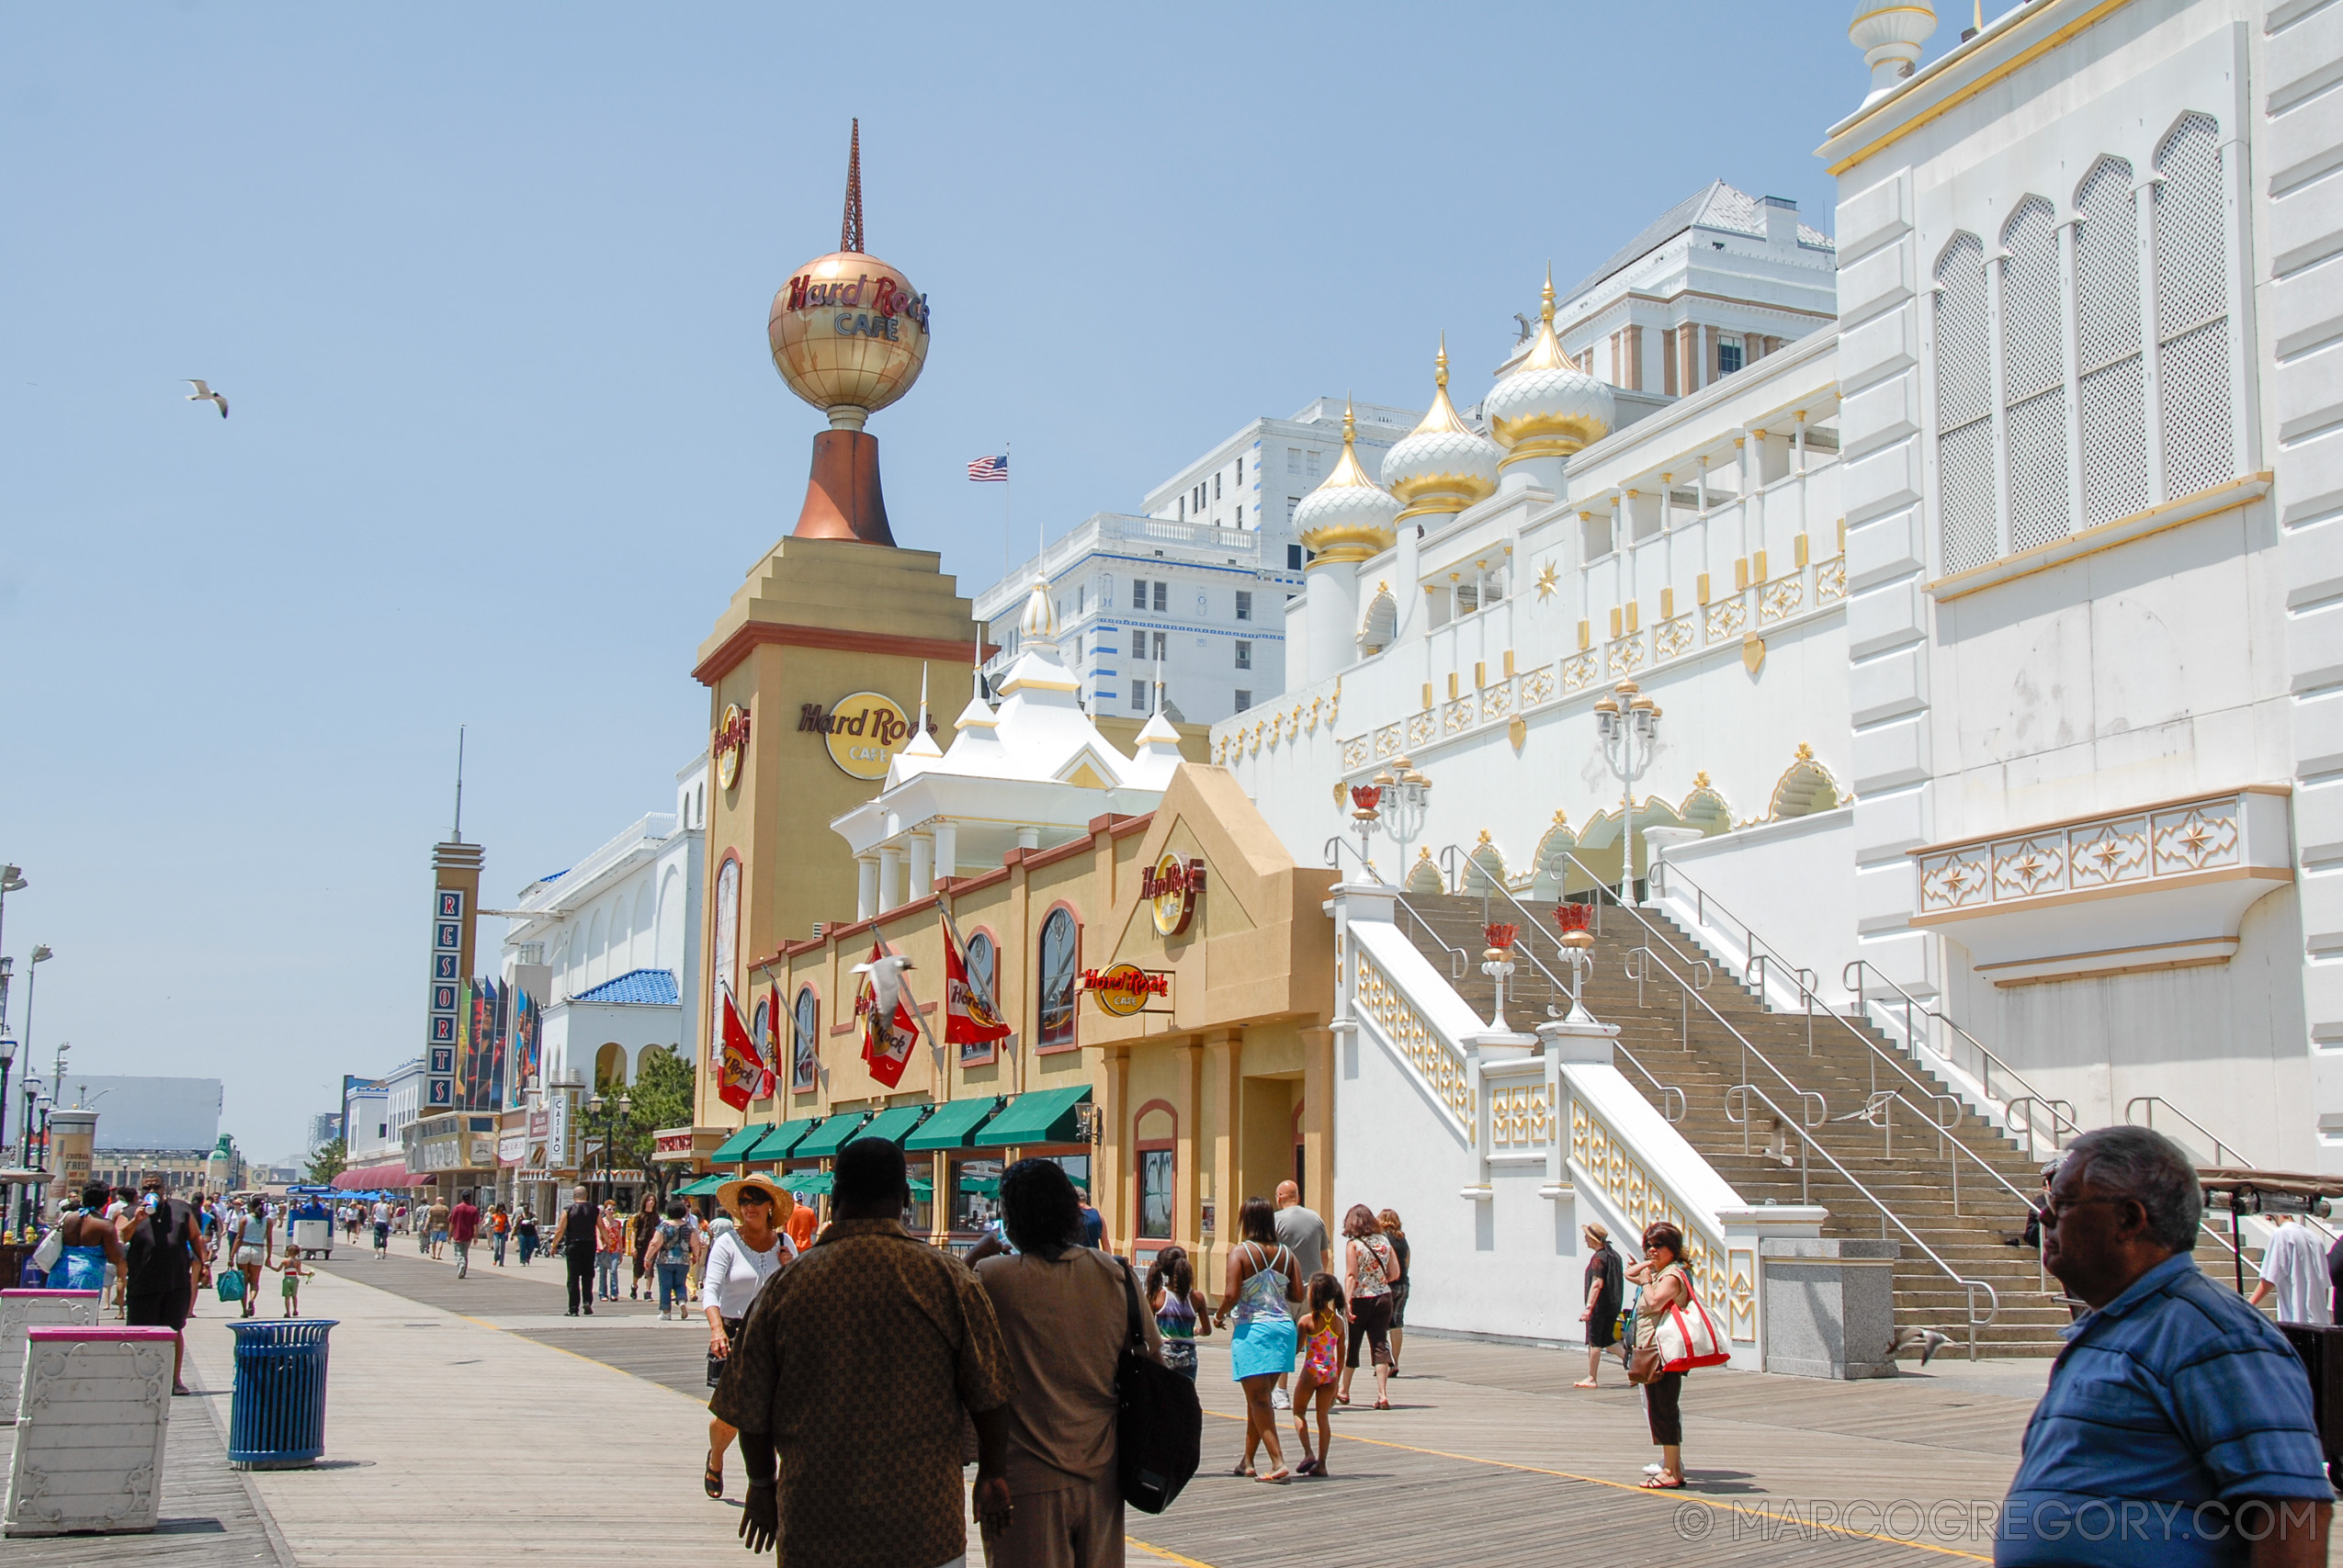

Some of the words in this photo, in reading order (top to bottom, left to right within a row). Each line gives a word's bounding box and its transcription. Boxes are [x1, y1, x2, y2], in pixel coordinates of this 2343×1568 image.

[787, 275, 866, 310] Hard
[872, 276, 930, 334] Rock
[834, 313, 899, 341] CAFE
[798, 703, 868, 736] Hard
[849, 746, 888, 762] CAFE
[436, 895, 456, 1101] RESORTS
[1084, 969, 1126, 989] Hard
[1126, 971, 1168, 997] Rock
[1114, 996, 1138, 1006] CAFE
[729, 1055, 753, 1085] Rock
[553, 1100, 562, 1152] CASINO
